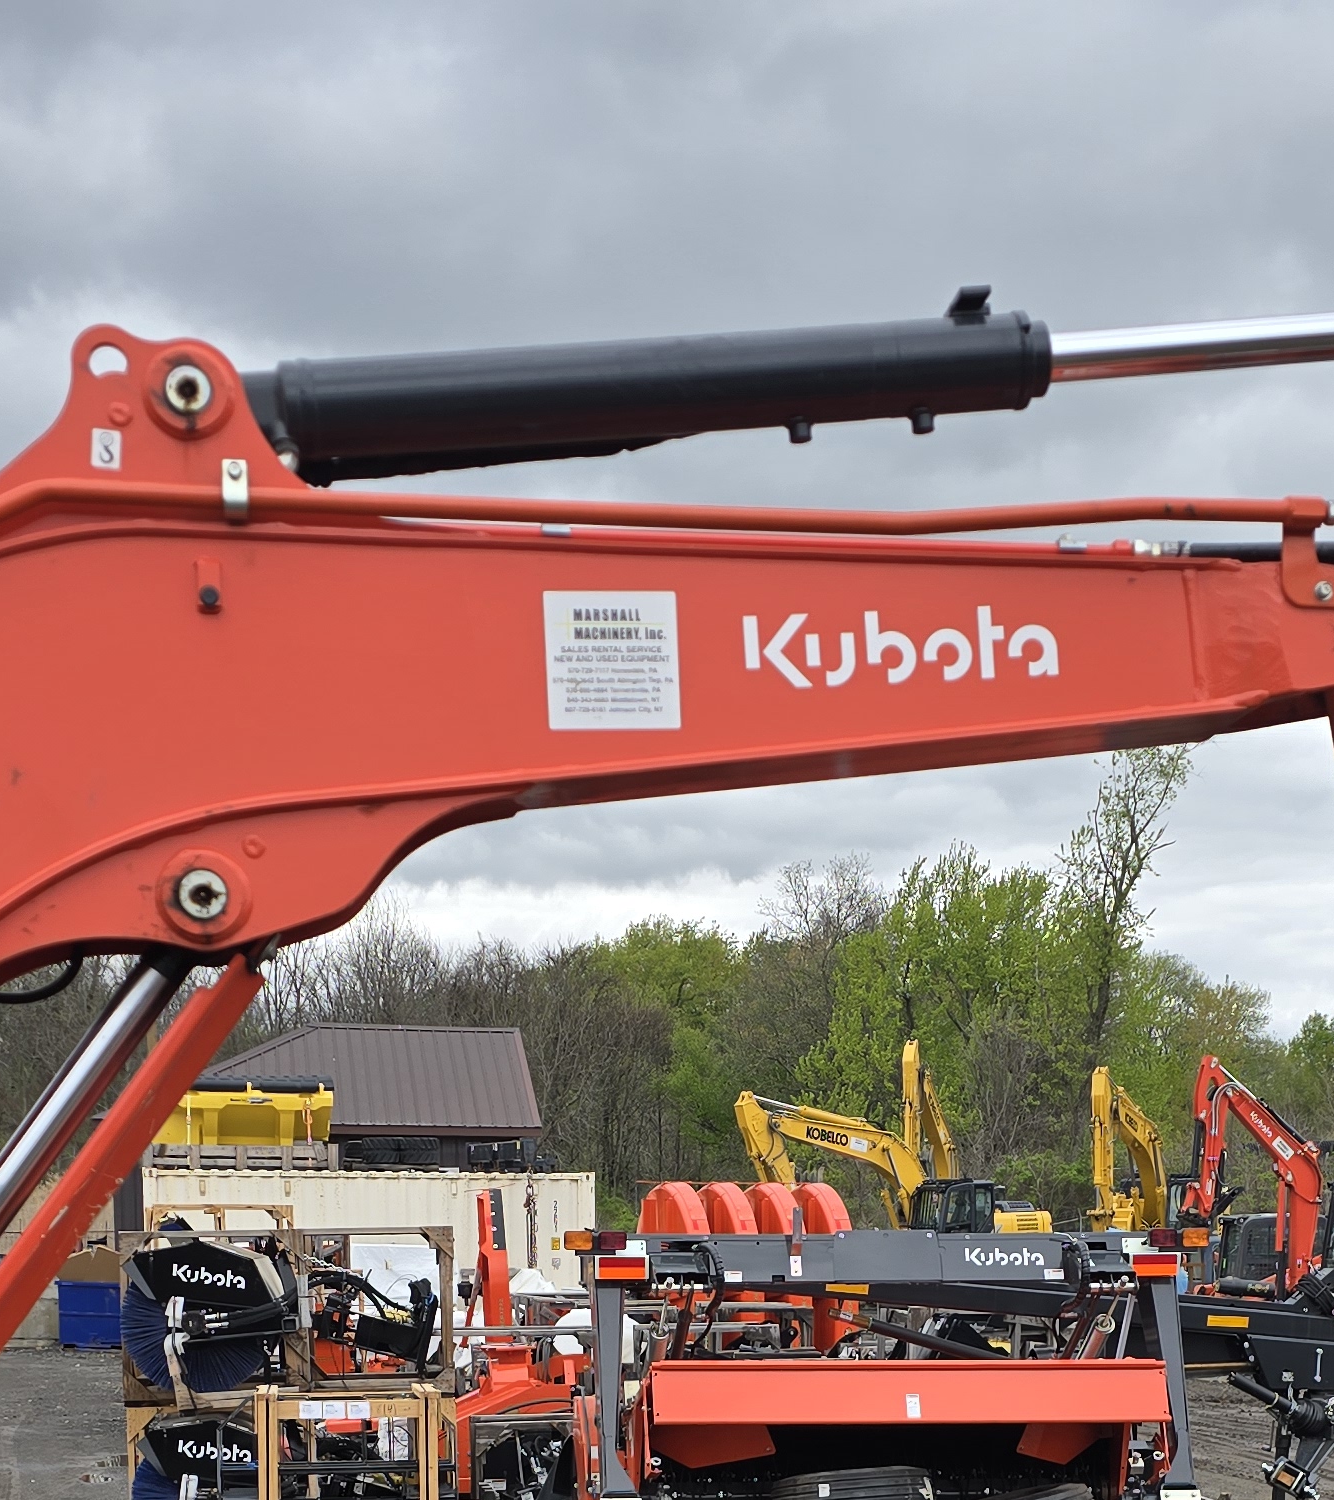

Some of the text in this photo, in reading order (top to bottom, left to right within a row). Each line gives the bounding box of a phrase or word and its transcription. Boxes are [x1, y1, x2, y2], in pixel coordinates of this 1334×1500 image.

[573, 608, 641, 622] MARSHALL
[574, 626, 667, 640] MACHINERY, Inc.
[561, 645, 662, 653] SALES RENTAL SERVICE
[742, 605, 1060, 690] Kubota
[553, 654, 670, 663] NEW AND USED EQUIPMENT
[1249, 1110, 1273, 1139] Kubota
[805, 1125, 849, 1147] KOBELCO
[964, 1247, 1045, 1266] Kubota
[172, 1263, 246, 1290] Kubota
[178, 1439, 252, 1463] Kubota
